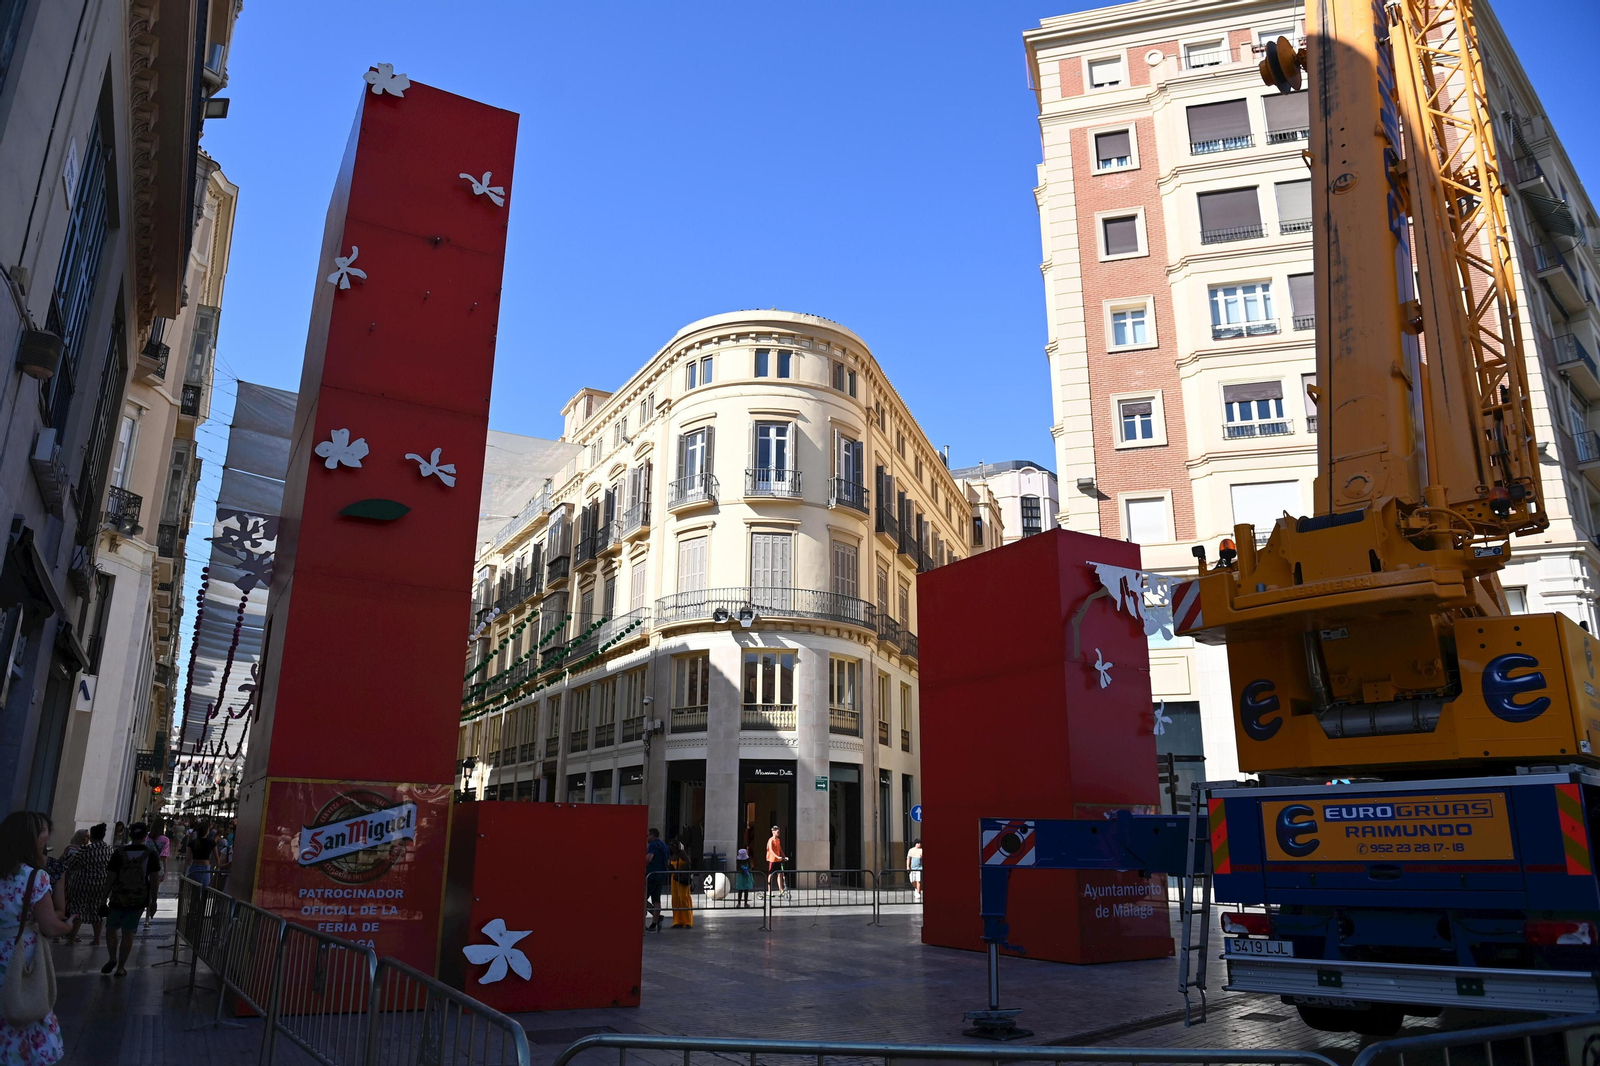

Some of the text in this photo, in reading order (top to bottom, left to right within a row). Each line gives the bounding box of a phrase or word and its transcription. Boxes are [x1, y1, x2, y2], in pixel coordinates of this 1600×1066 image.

[320, 802, 340, 823] CERVEZA
[1345, 823, 1473, 838] RAIMUNDO
[1370, 843, 1394, 853] 952
[1396, 843, 1412, 853] 23
[1414, 843, 1431, 853] 28
[298, 888, 405, 899] PATROCINADOR
[1084, 882, 1162, 901] Ayuntamiento
[301, 905, 399, 916] OFICIAL DE LA
[1095, 902, 1154, 919] de Málaga
[317, 922, 380, 933] FERIA DE
[1234, 940, 1289, 955] 5419 LJL
[1292, 994, 1357, 1008] SCANIA
